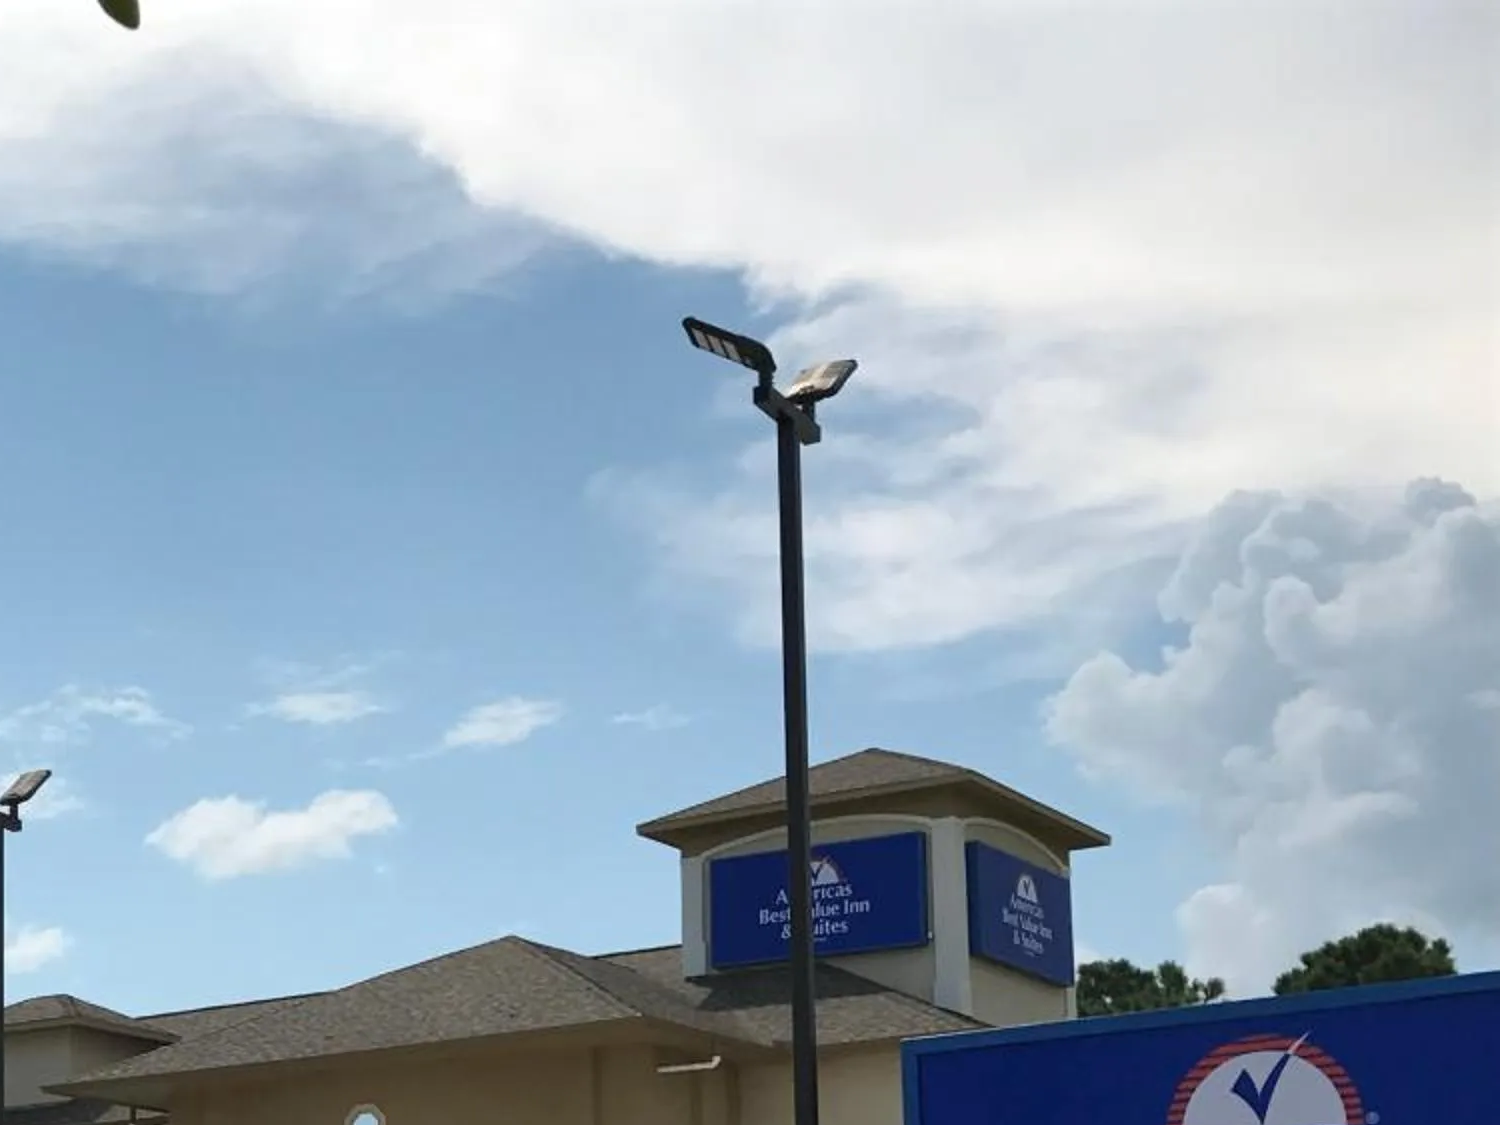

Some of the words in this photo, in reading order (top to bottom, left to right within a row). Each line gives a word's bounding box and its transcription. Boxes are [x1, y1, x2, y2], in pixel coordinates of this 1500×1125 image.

[775, 884, 853, 905] Aricas
[759, 907, 791, 925] Best
[844, 899, 871, 915] Inn
